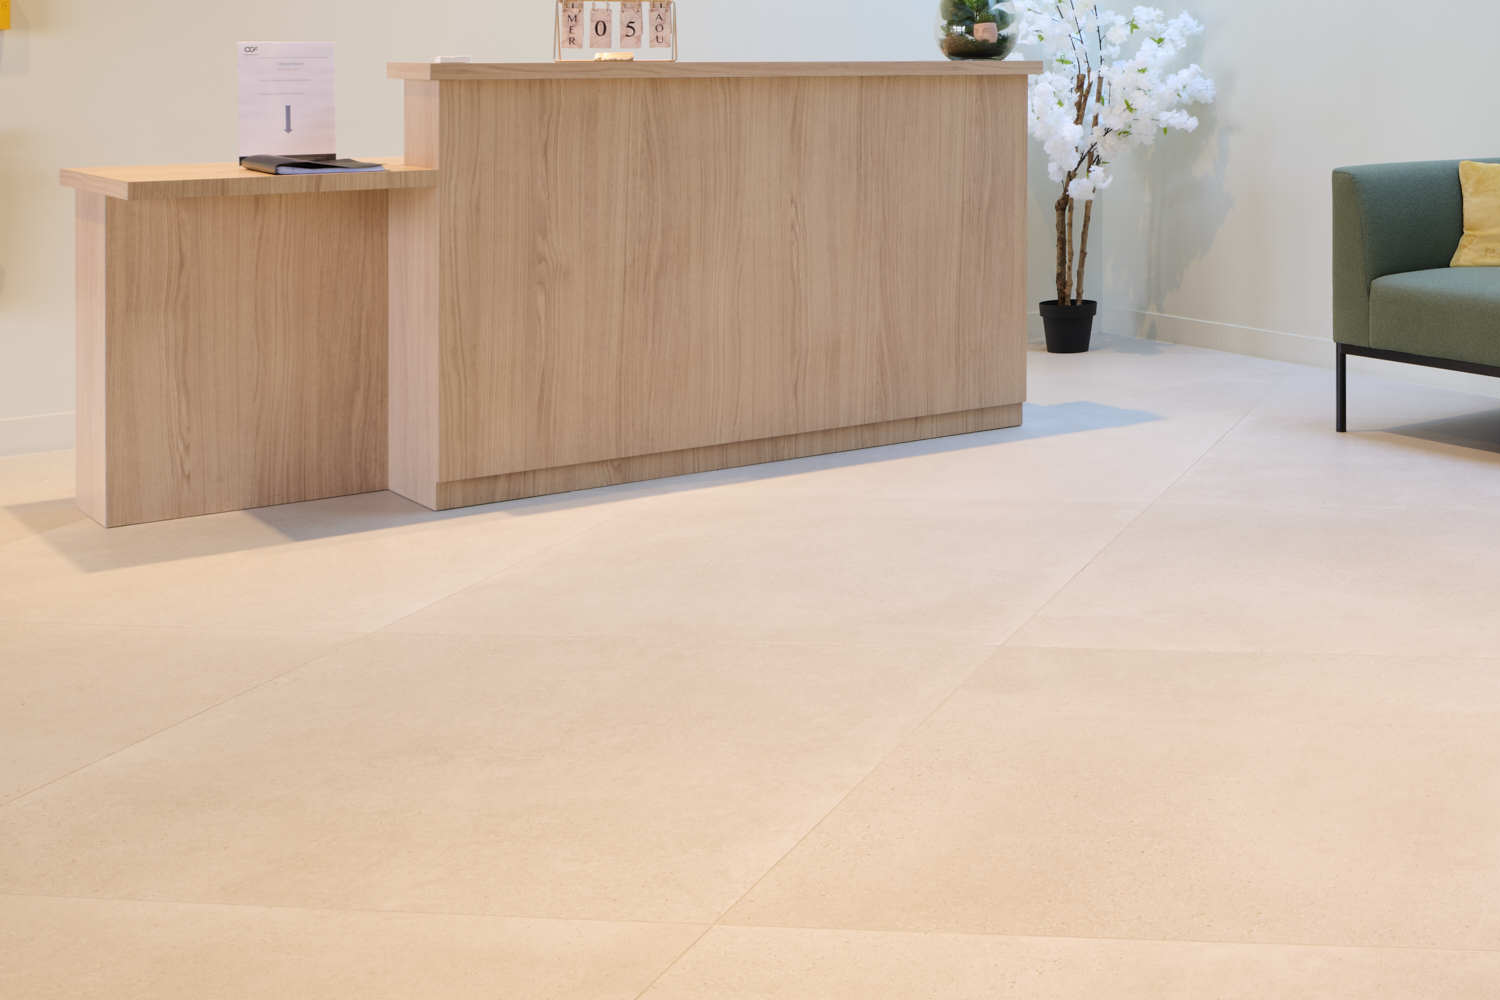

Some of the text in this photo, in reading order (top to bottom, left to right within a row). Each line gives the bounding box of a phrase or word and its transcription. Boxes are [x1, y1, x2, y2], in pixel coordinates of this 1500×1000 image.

[567, 14, 578, 45] MER
[594, 20, 636, 38] 0 5
